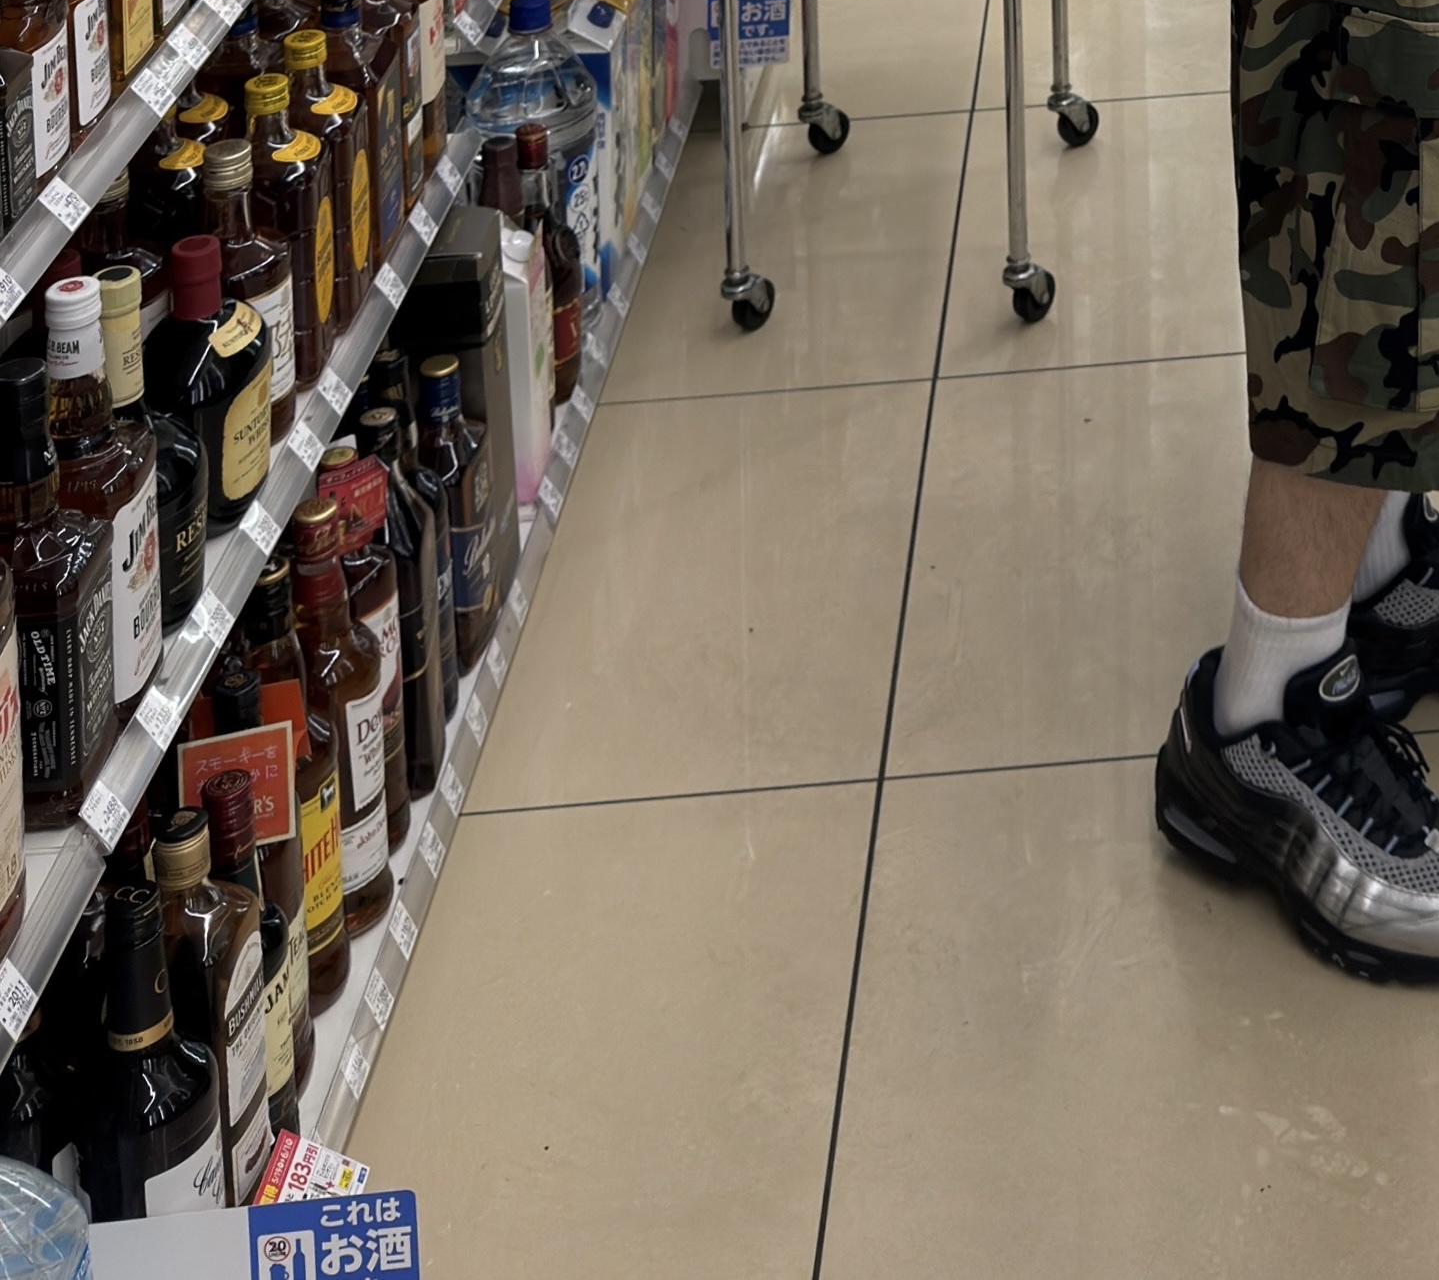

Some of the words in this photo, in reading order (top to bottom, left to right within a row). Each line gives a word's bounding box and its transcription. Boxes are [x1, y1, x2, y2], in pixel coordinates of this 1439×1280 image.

[741, 0, 787, 23] お酒
[741, 24, 774, 37] です。
[56, 340, 80, 354] BEAM
[30, 631, 45, 654] OLD
[40, 654, 56, 685] TIME
[196, 745, 278, 774] スモーキーを
[288, 1143, 321, 1192] 183円引
[320, 1197, 401, 1227] これは
[320, 1226, 412, 1275] お酒
